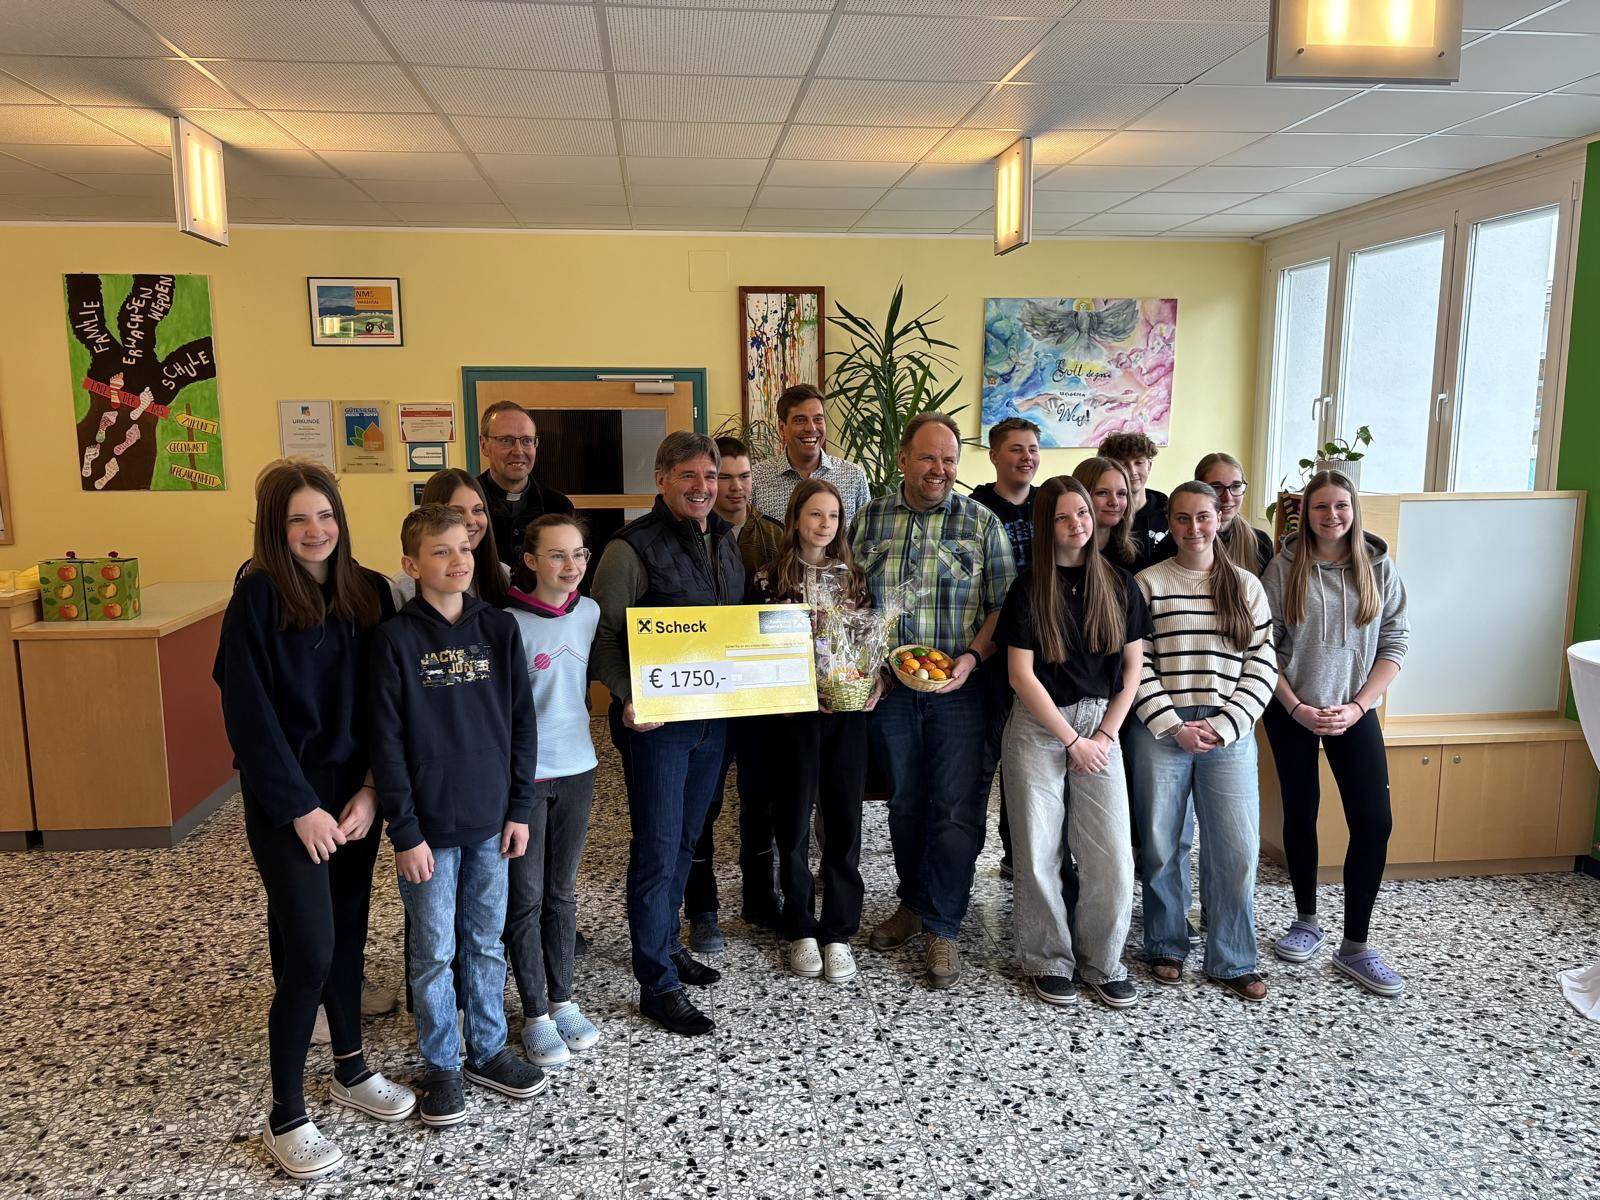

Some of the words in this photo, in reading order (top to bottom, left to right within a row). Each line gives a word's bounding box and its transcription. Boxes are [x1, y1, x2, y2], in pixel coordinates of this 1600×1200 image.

[147, 275, 173, 321] WERDEN
[75, 301, 111, 354] FAMILIE
[122, 287, 153, 365] ERWACHSEN
[162, 350, 210, 390] SCHULE
[1052, 359, 1083, 383] Gott
[1056, 403, 1090, 427] Weg!
[655, 620, 708, 634] Scheck
[648, 667, 664, 689] €
[670, 668, 727, 689] 1750,-
